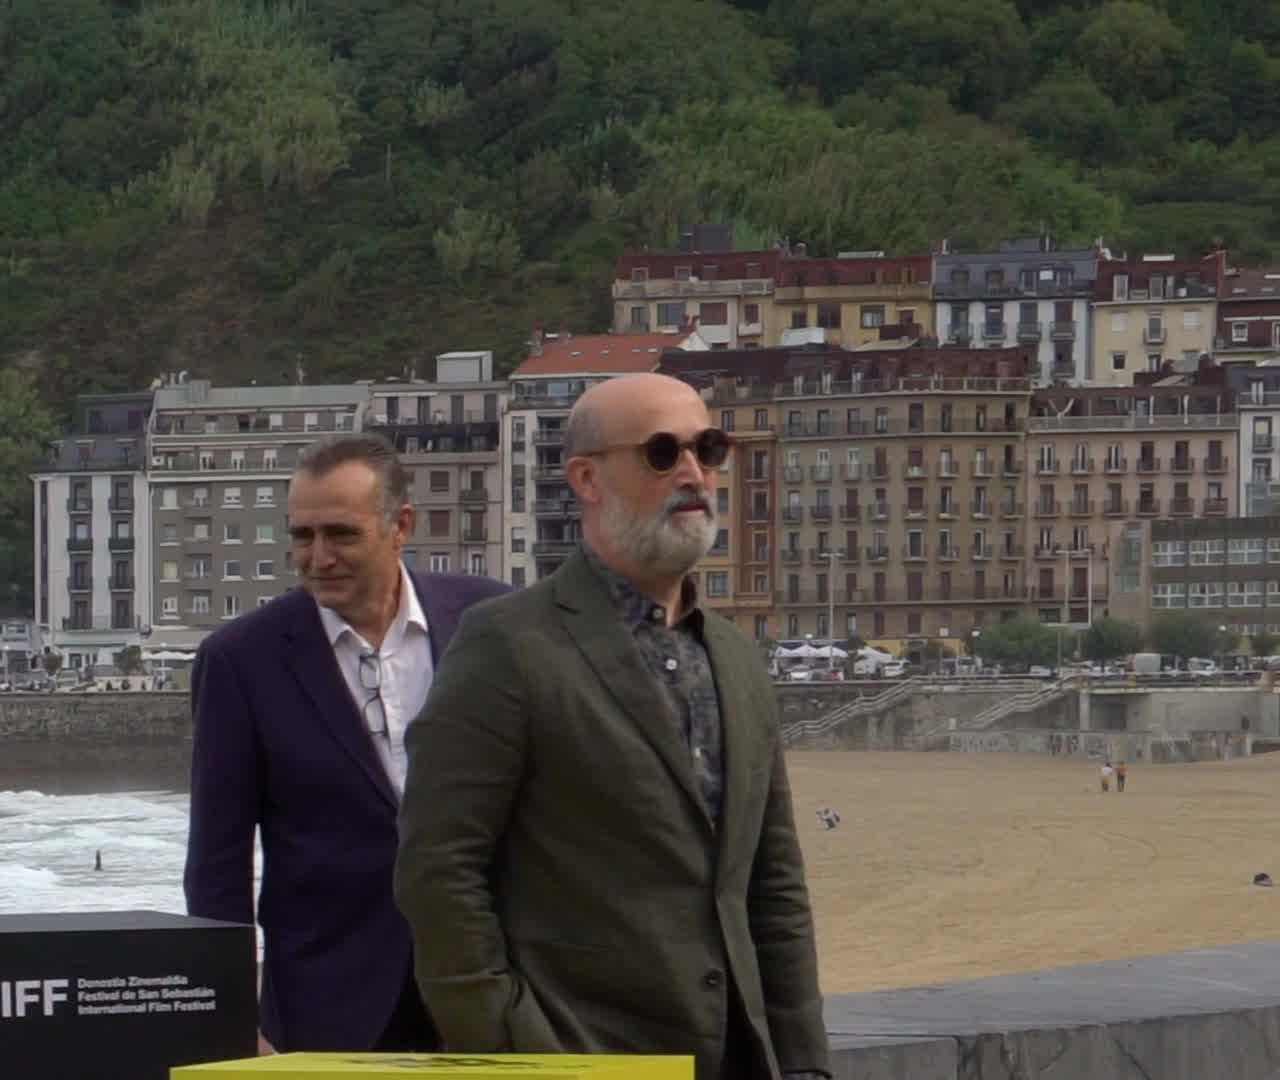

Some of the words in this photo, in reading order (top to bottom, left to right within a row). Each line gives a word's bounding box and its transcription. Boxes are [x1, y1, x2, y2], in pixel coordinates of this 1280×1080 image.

[78, 990, 120, 1002] Festival
[122, 990, 136, 1000] de
[137, 989, 159, 1000] San
[78, 1003, 147, 1015] International
[148, 1001, 172, 1013] Film
[173, 1000, 216, 1012] Festival
